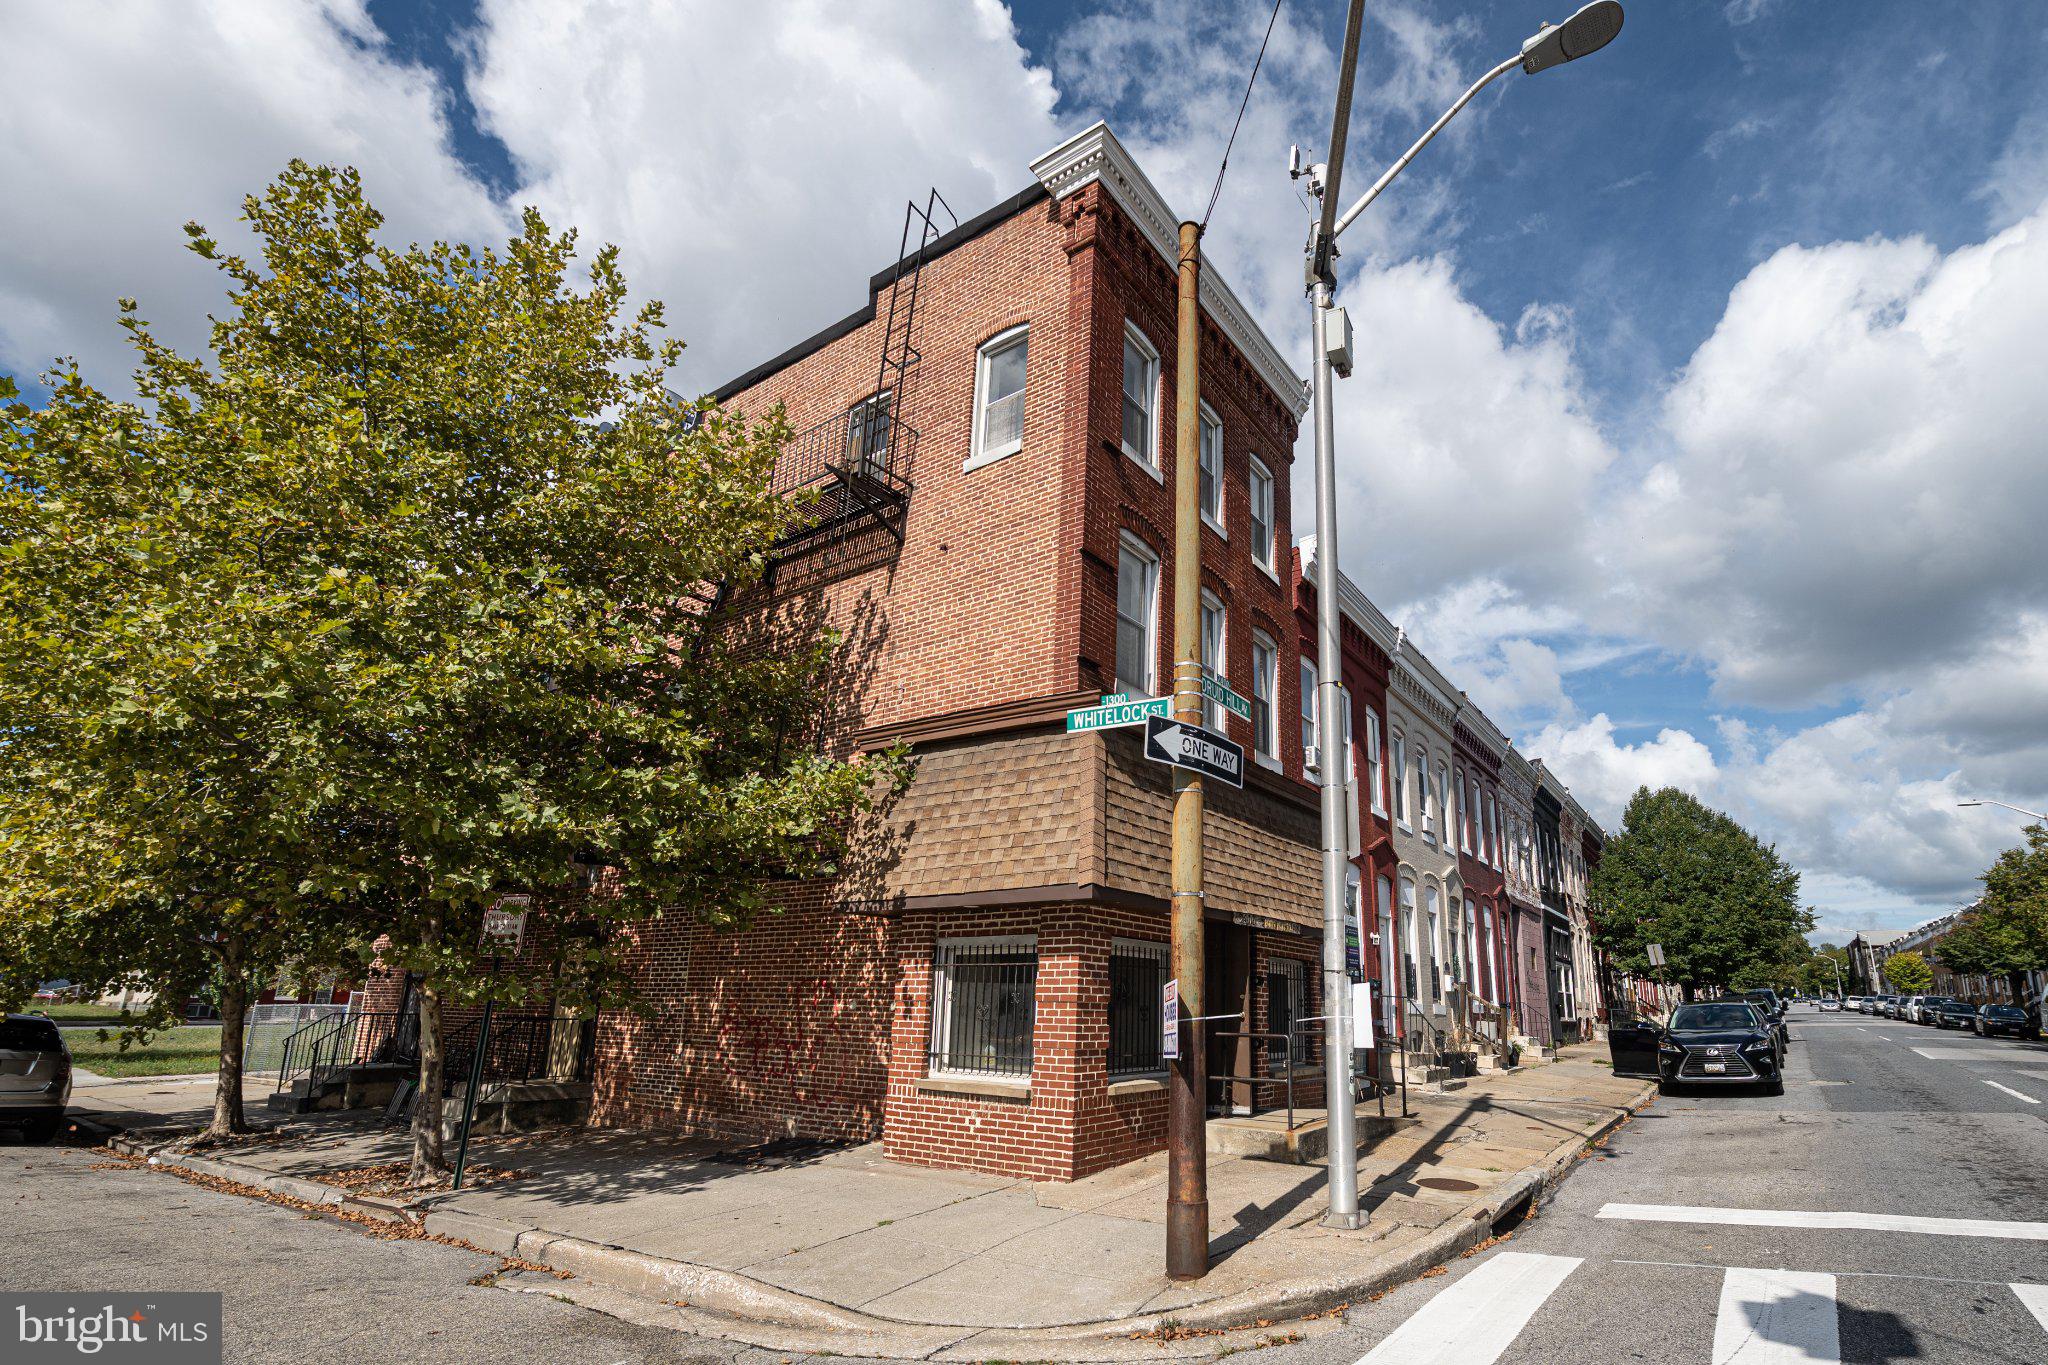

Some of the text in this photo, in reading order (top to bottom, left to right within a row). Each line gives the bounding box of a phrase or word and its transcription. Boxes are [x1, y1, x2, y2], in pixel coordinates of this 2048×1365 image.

[1202, 677, 1224, 702] DRUID
[1226, 691, 1241, 714] HILL
[1073, 703, 1149, 729] WHITELOCK
[1182, 737, 1235, 770] ONE WAY
